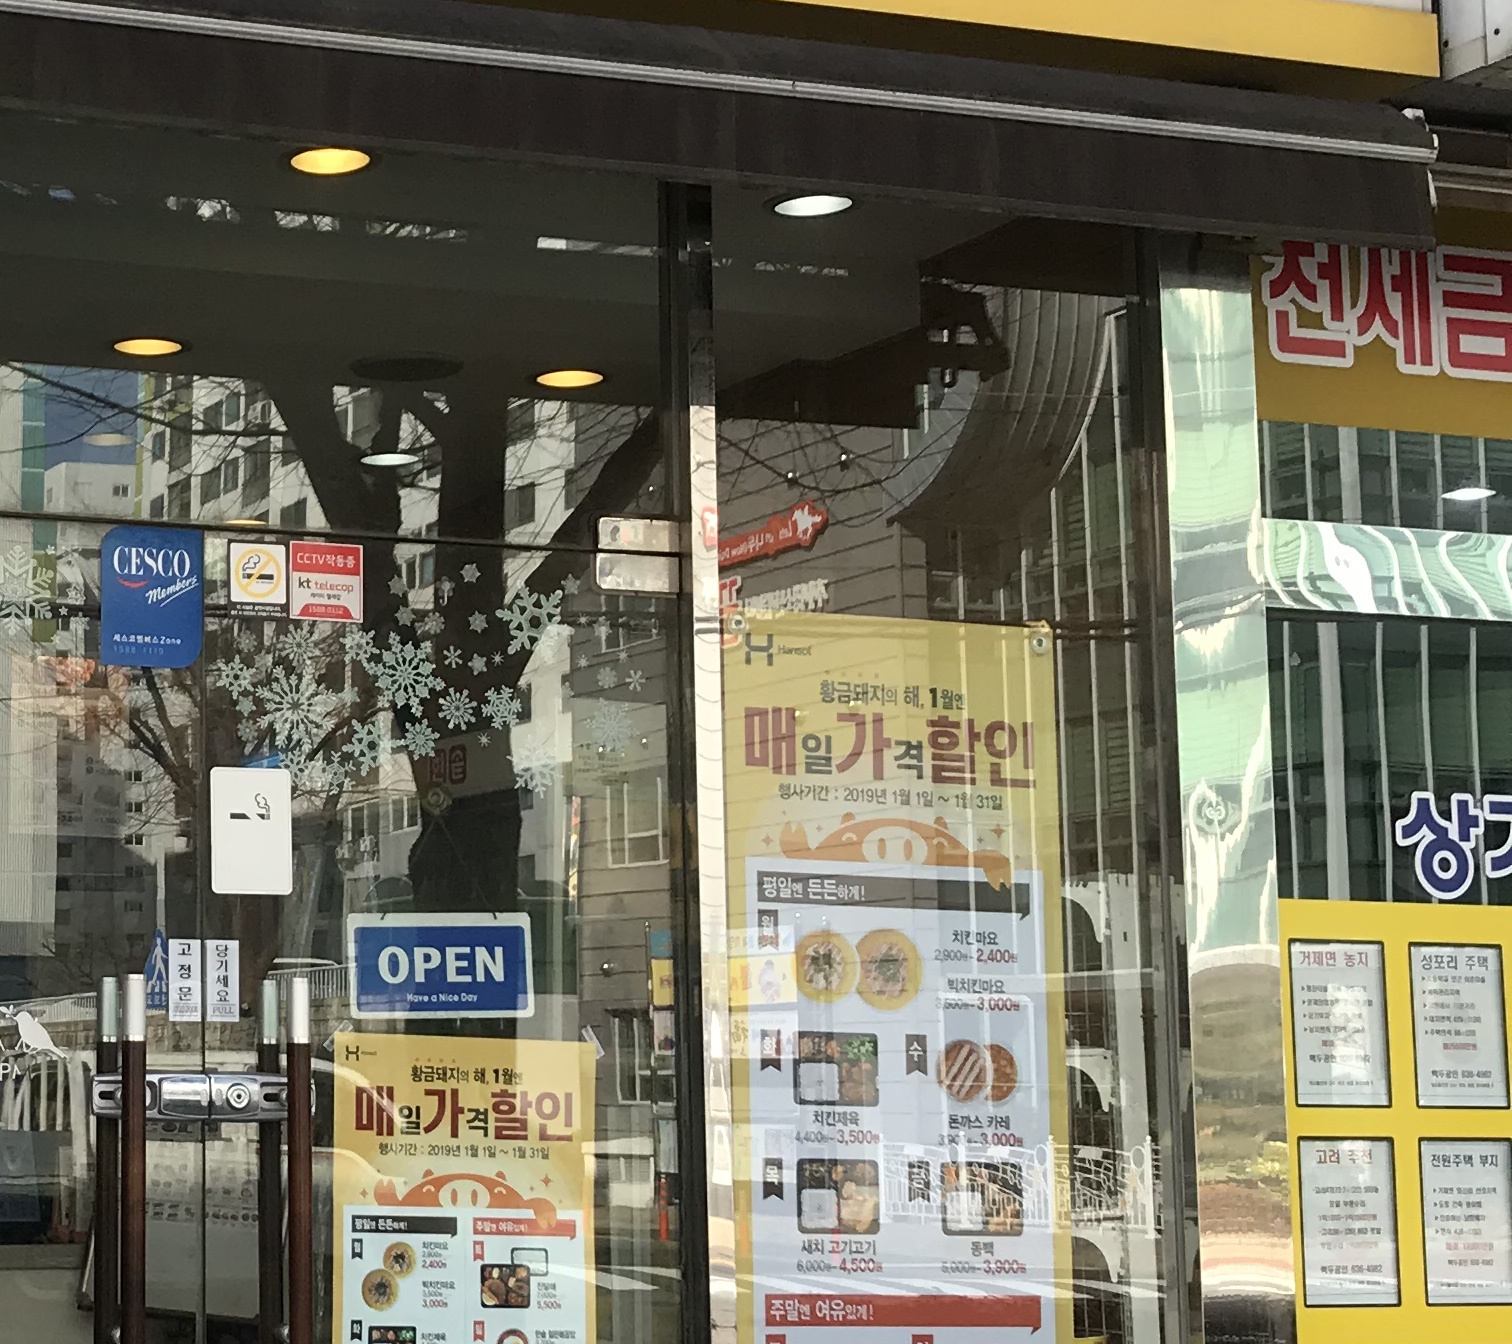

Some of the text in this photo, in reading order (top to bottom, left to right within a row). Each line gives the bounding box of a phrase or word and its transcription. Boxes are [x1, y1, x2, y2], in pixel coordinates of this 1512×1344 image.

[113, 545, 190, 577] CESCO
[146, 574, 198, 605] Members
[298, 576, 353, 593] kt telecop
[820, 680, 898, 706] 황금돼지의
[779, 783, 1003, 810] 행사기간 2019년 1월 1일 31일
[762, 877, 865, 901] 평일엔 든든하게!
[952, 930, 999, 945] 치킨마요
[377, 945, 505, 984] OPEN
[1344, 951, 1368, 967] 농지
[1421, 955, 1488, 971] 성포리 주택
[178, 943, 192, 1001] 고정문
[216, 944, 229, 1002] 당기세요
[407, 992, 426, 1003] Have
[438, 992, 459, 1003] Nice
[462, 992, 478, 1005] Day
[909, 1041, 923, 1061] 수
[411, 1066, 469, 1083] 황금돼지의
[812, 1110, 860, 1126] 치킨제육
[949, 1114, 983, 1130] 돈까스
[379, 1143, 418, 1156] 행사기간
[428, 1144, 461, 1158] 2019년
[464, 1145, 479, 1158] 1월
[482, 1146, 496, 1158] 1일
[530, 1146, 550, 1159] 31일
[1316, 1149, 1340, 1164] 고려
[1431, 1154, 1498, 1167] 전원주택 부지
[829, 1240, 877, 1255] 고기고기
[770, 1299, 874, 1322] 주말엔 여유있게!
